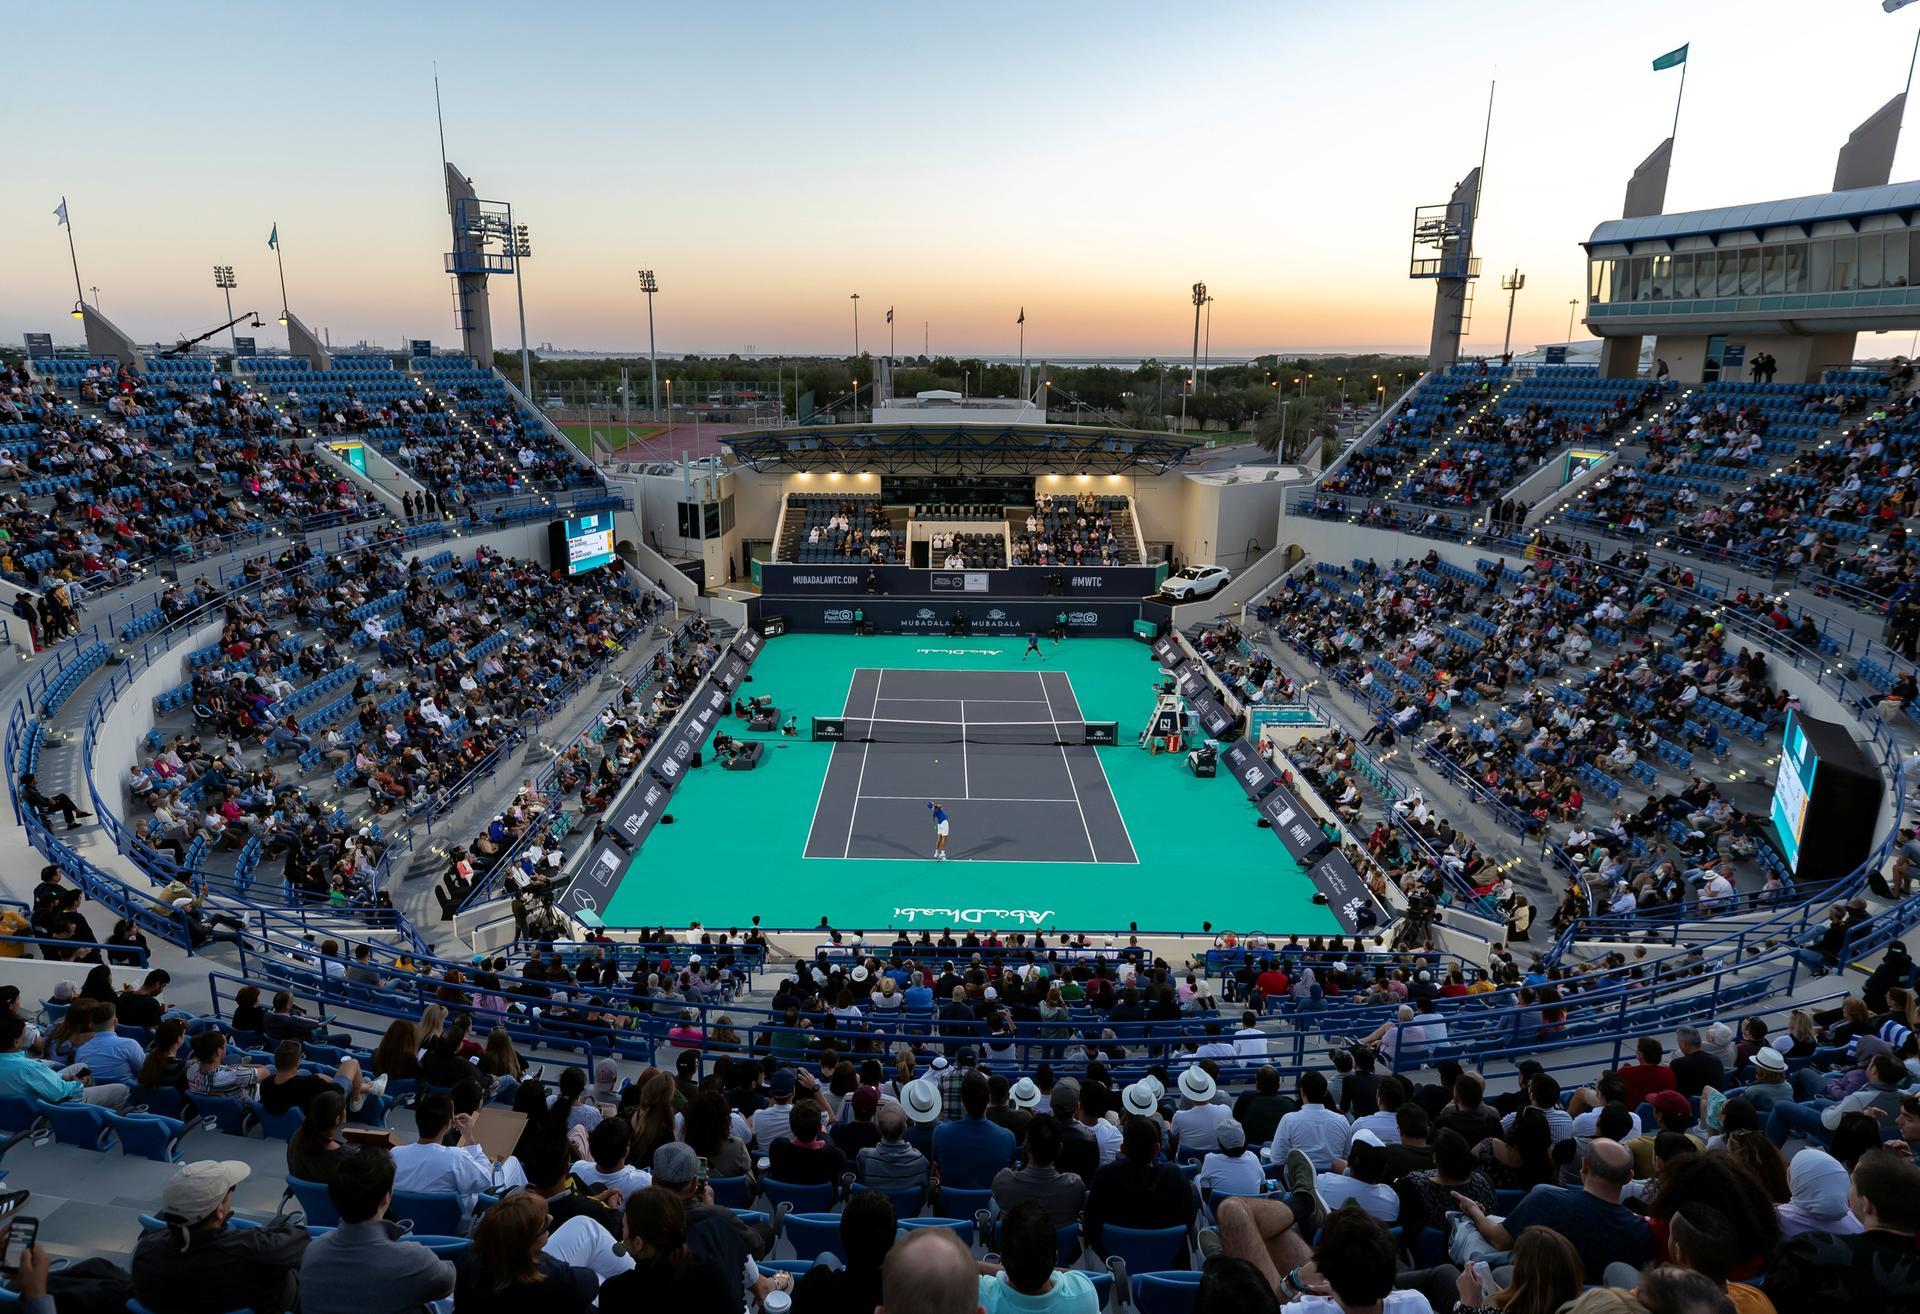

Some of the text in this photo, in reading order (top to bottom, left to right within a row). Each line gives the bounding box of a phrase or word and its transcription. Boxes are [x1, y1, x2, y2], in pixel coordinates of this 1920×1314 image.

[793, 576, 858, 585] MUBADALAWTC.COM
[1071, 576, 1102, 587] #MWTC
[662, 756, 680, 777] CNN
[1245, 766, 1265, 787] CNN
[644, 785, 661, 807] #MWTC
[1289, 823, 1311, 846] #MWTC
